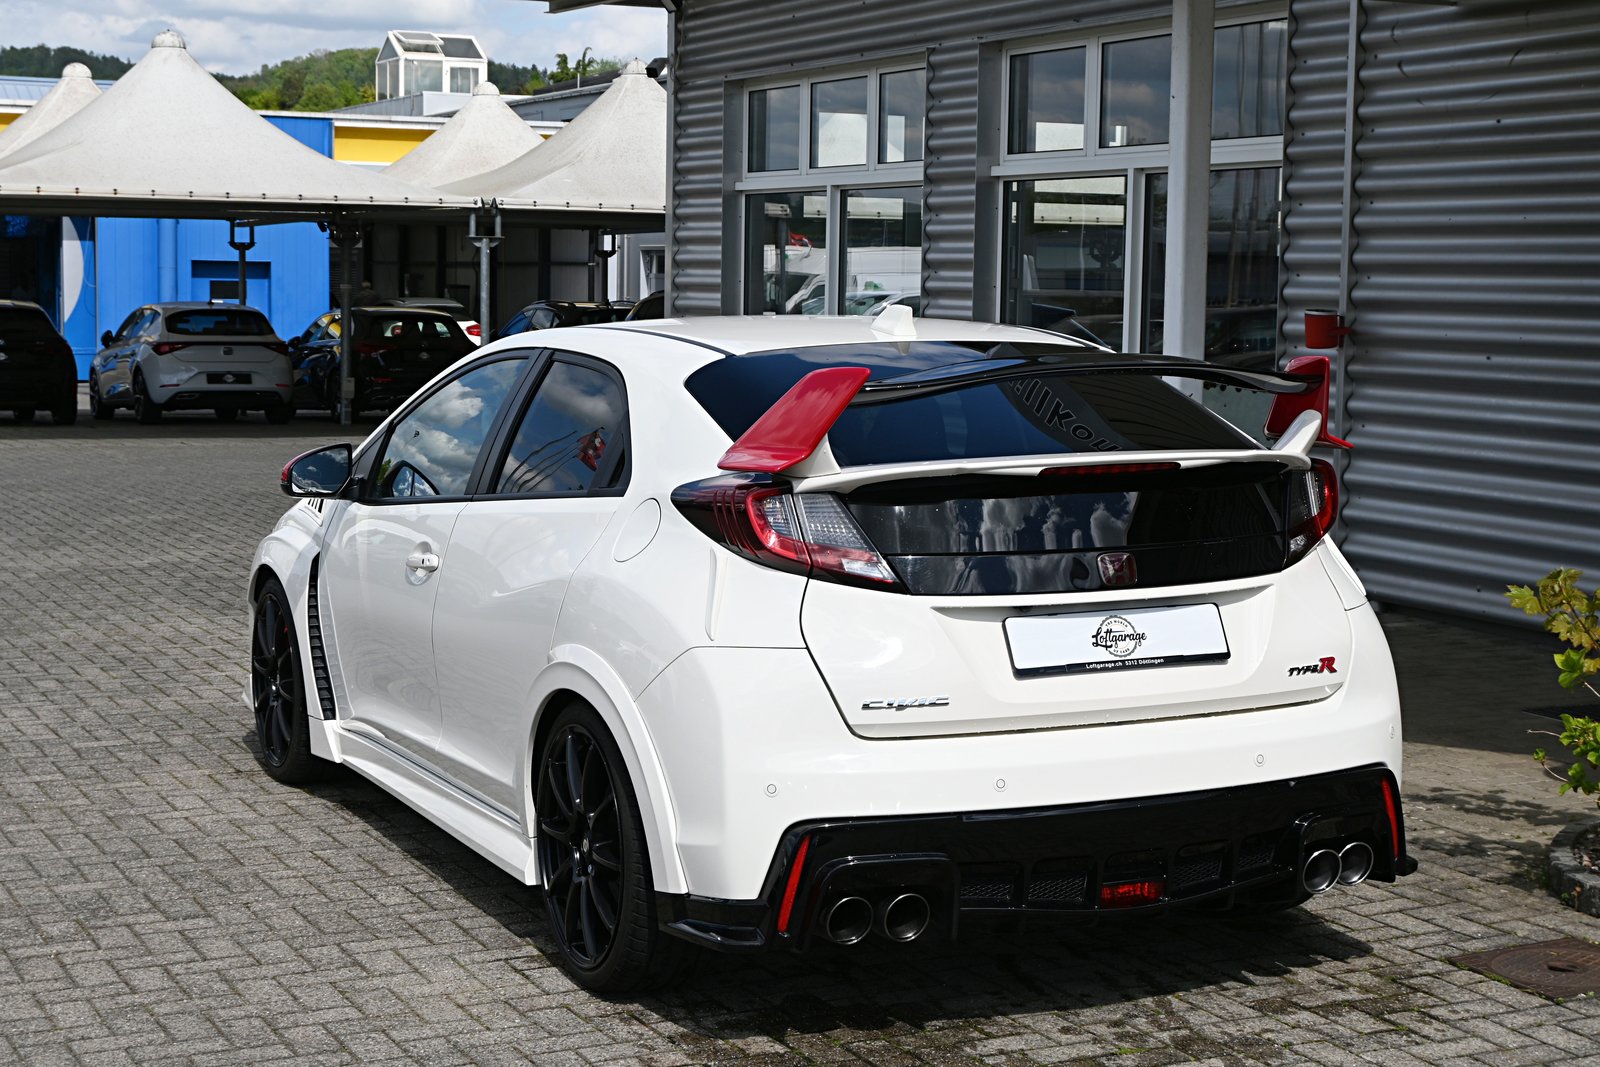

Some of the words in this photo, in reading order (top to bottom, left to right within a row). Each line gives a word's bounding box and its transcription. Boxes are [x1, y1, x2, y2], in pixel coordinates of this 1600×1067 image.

[1092, 626, 1147, 651] Loftgarage
[1085, 661, 1123, 669] Loftgarage.ch
[1288, 664, 1319, 677] TYPE
[1318, 656, 1338, 674] R
[862, 695, 950, 711] CIVIC
